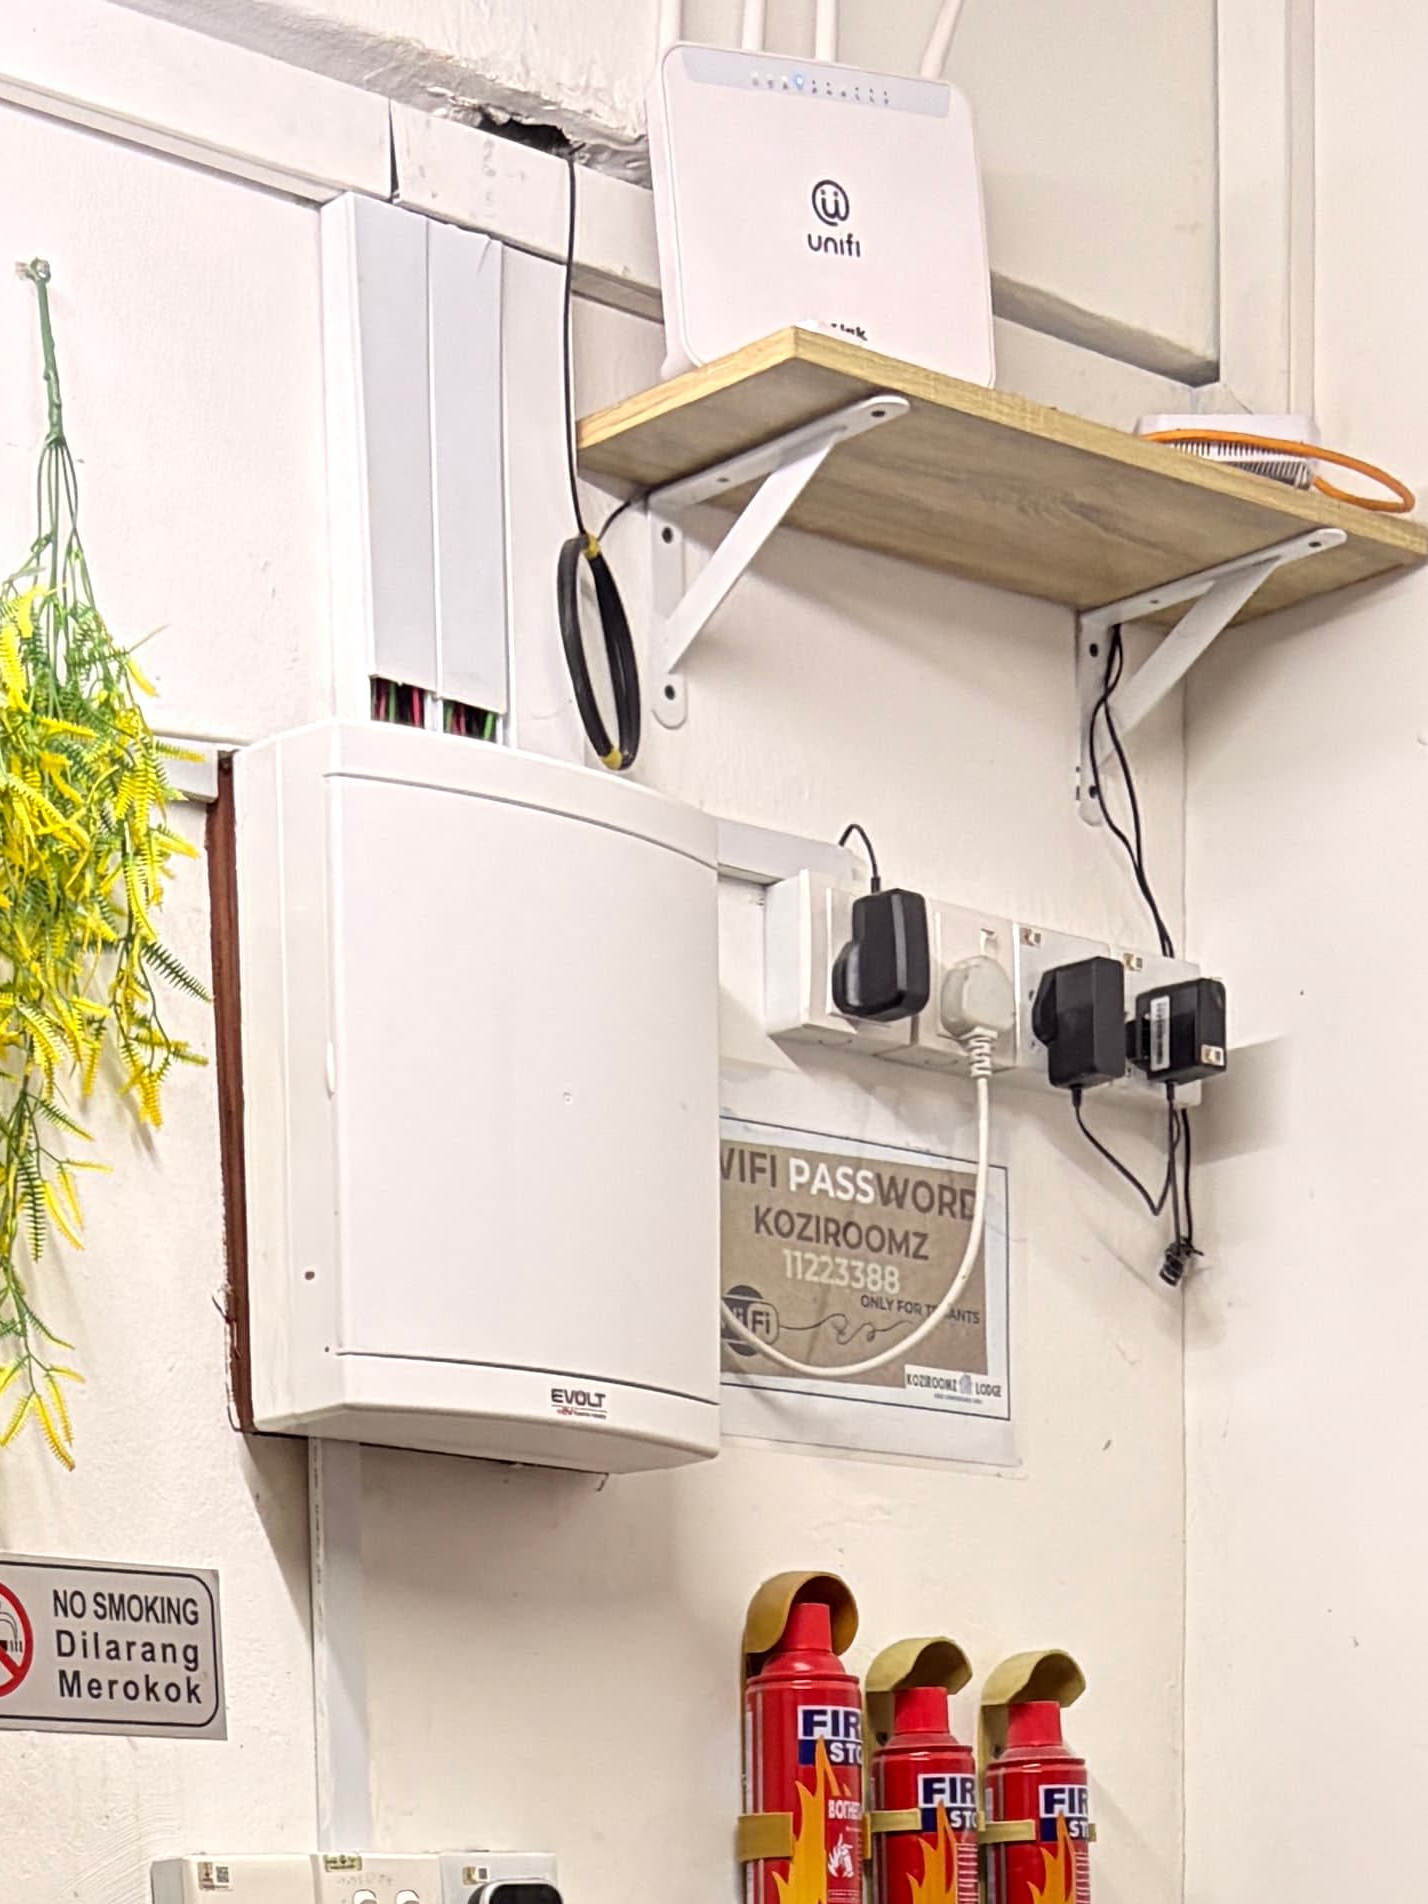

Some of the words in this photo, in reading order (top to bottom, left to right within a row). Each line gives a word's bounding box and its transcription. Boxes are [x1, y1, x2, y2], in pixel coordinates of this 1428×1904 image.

[807, 233, 861, 258] unifi
[754, 1205, 929, 1260] KOZIROOMZ
[783, 1248, 901, 1294] 11223388
[860, 1295, 894, 1311] ONLY
[897, 1300, 922, 1315] FOR
[923, 1304, 980, 1324] TANTS
[551, 1388, 606, 1408] EVOLT
[52, 1589, 86, 1618] NO
[93, 1591, 199, 1626] SMOKING
[56, 1629, 199, 1672] Dilarang
[58, 1669, 202, 1704] Merokok
